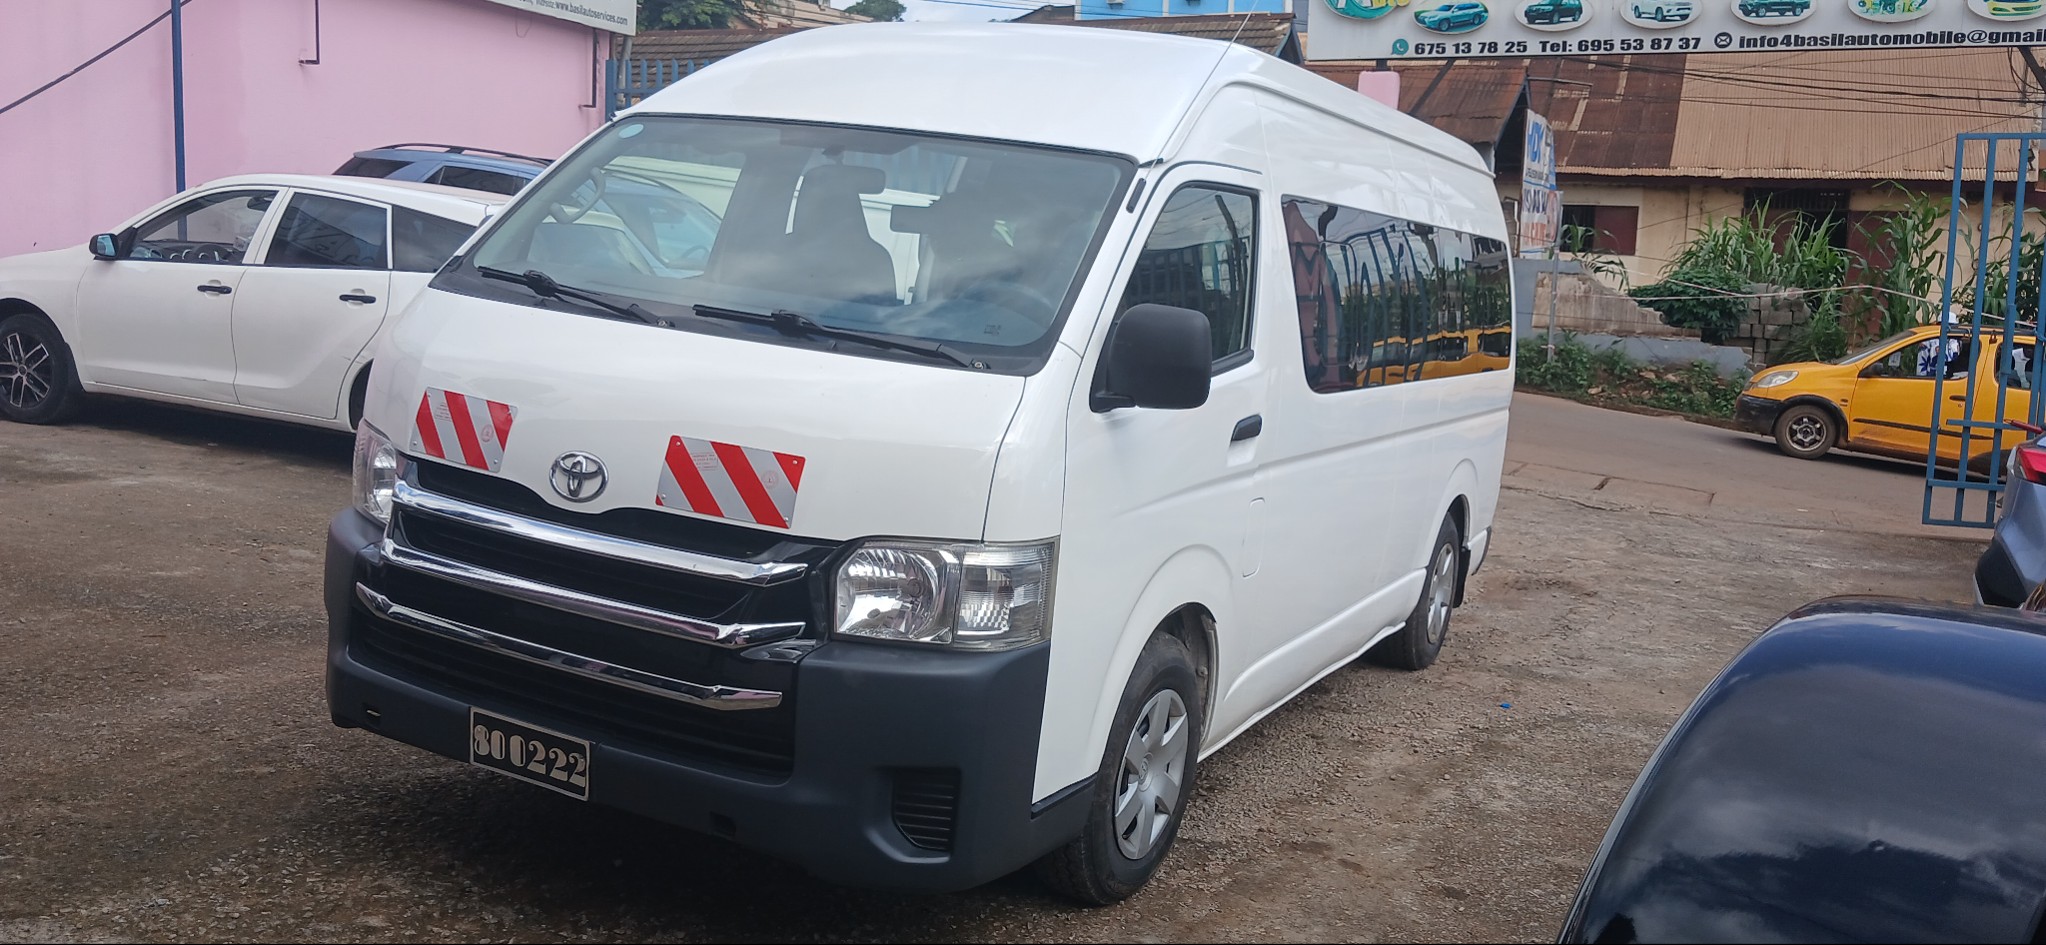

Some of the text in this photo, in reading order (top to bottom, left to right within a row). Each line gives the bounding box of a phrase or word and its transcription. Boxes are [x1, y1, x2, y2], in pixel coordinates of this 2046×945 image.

[1414, 42, 1446, 55] 675
[1452, 42, 1472, 54] 13
[1478, 41, 1498, 54] 78
[1505, 41, 1528, 53] 25
[1539, 40, 1573, 52] Tel:
[1577, 39, 1615, 51] 695
[1620, 38, 1644, 50] 53
[1650, 38, 1673, 50] 87
[1678, 37, 1701, 49] 37
